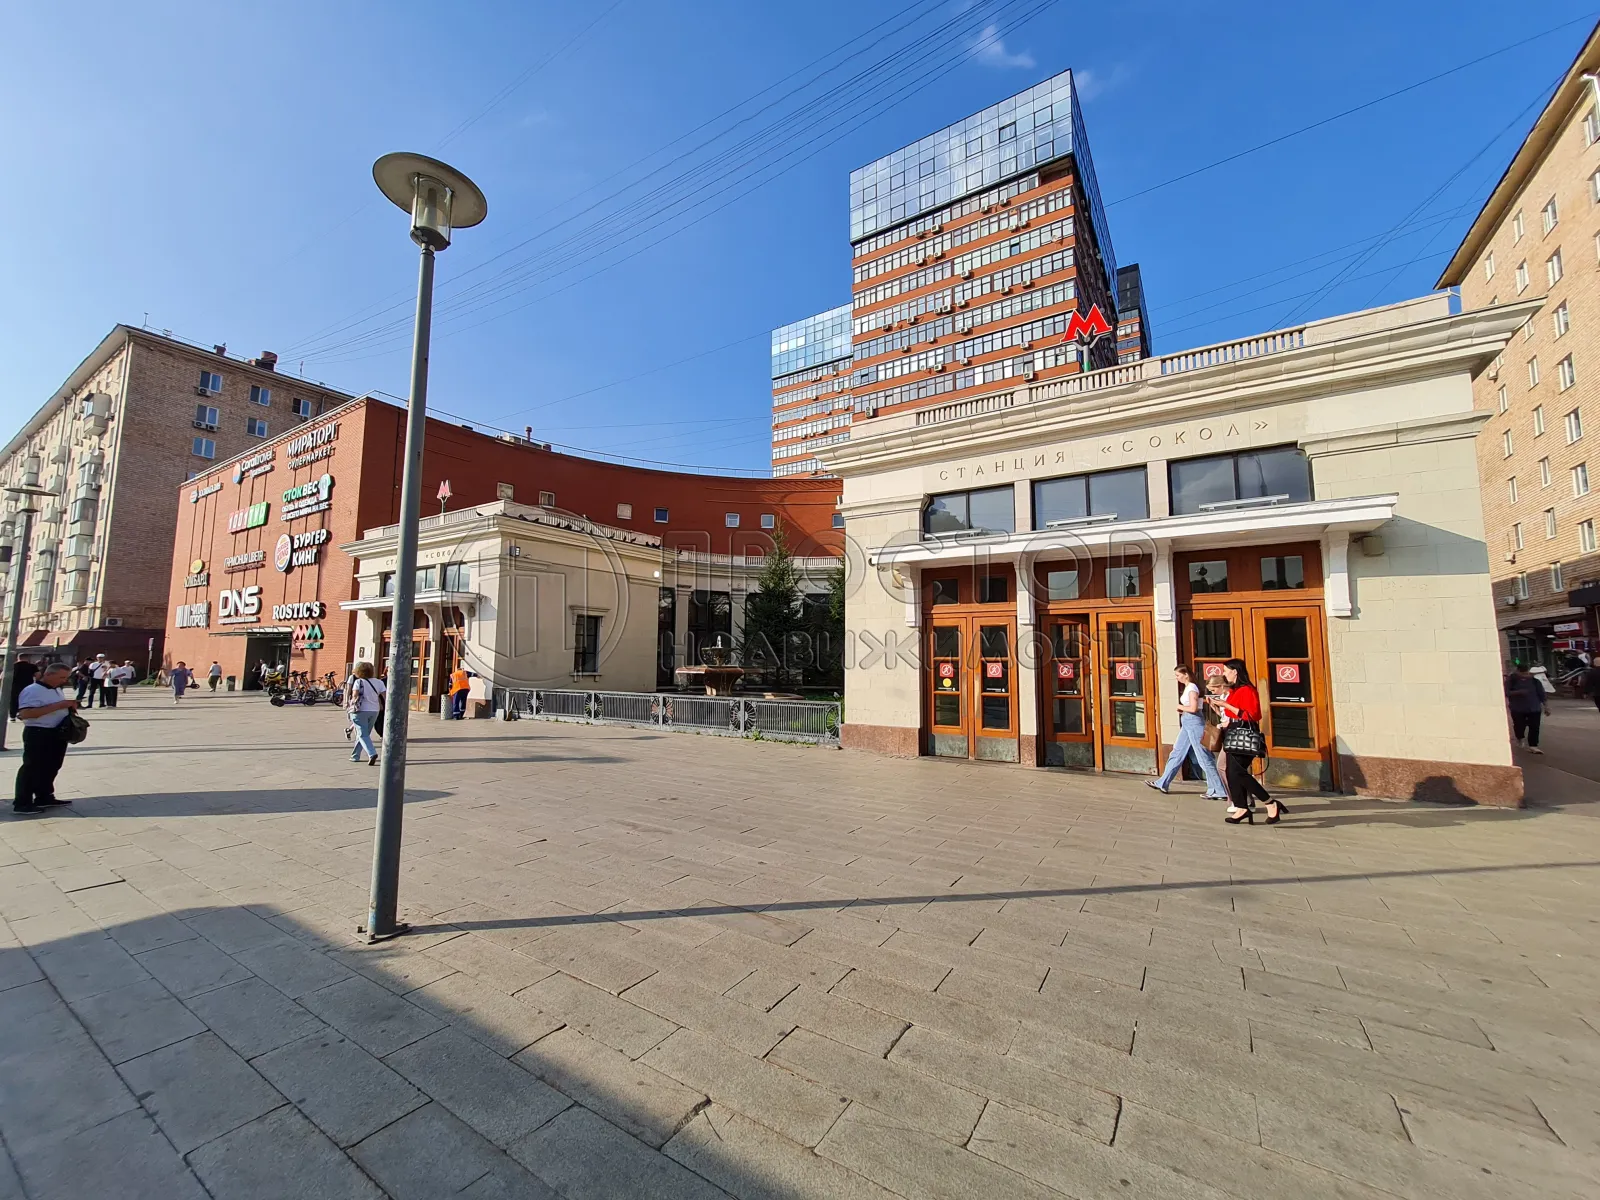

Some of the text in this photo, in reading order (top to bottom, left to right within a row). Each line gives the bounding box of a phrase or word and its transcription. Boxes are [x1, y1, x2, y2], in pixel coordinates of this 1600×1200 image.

[286, 421, 338, 458] МИРАТОРГ
[939, 421, 1269, 482] СТАНЦИЯ «СОКОЛ»
[288, 445, 333, 470] СУПЕРМАРКЕТ
[282, 480, 318, 503] СТОКВЕС
[293, 528, 327, 549] БУРГЕР
[292, 548, 317, 566] КИНГ
[218, 585, 260, 617] DNS
[272, 601, 320, 620] ROSTIC'S
